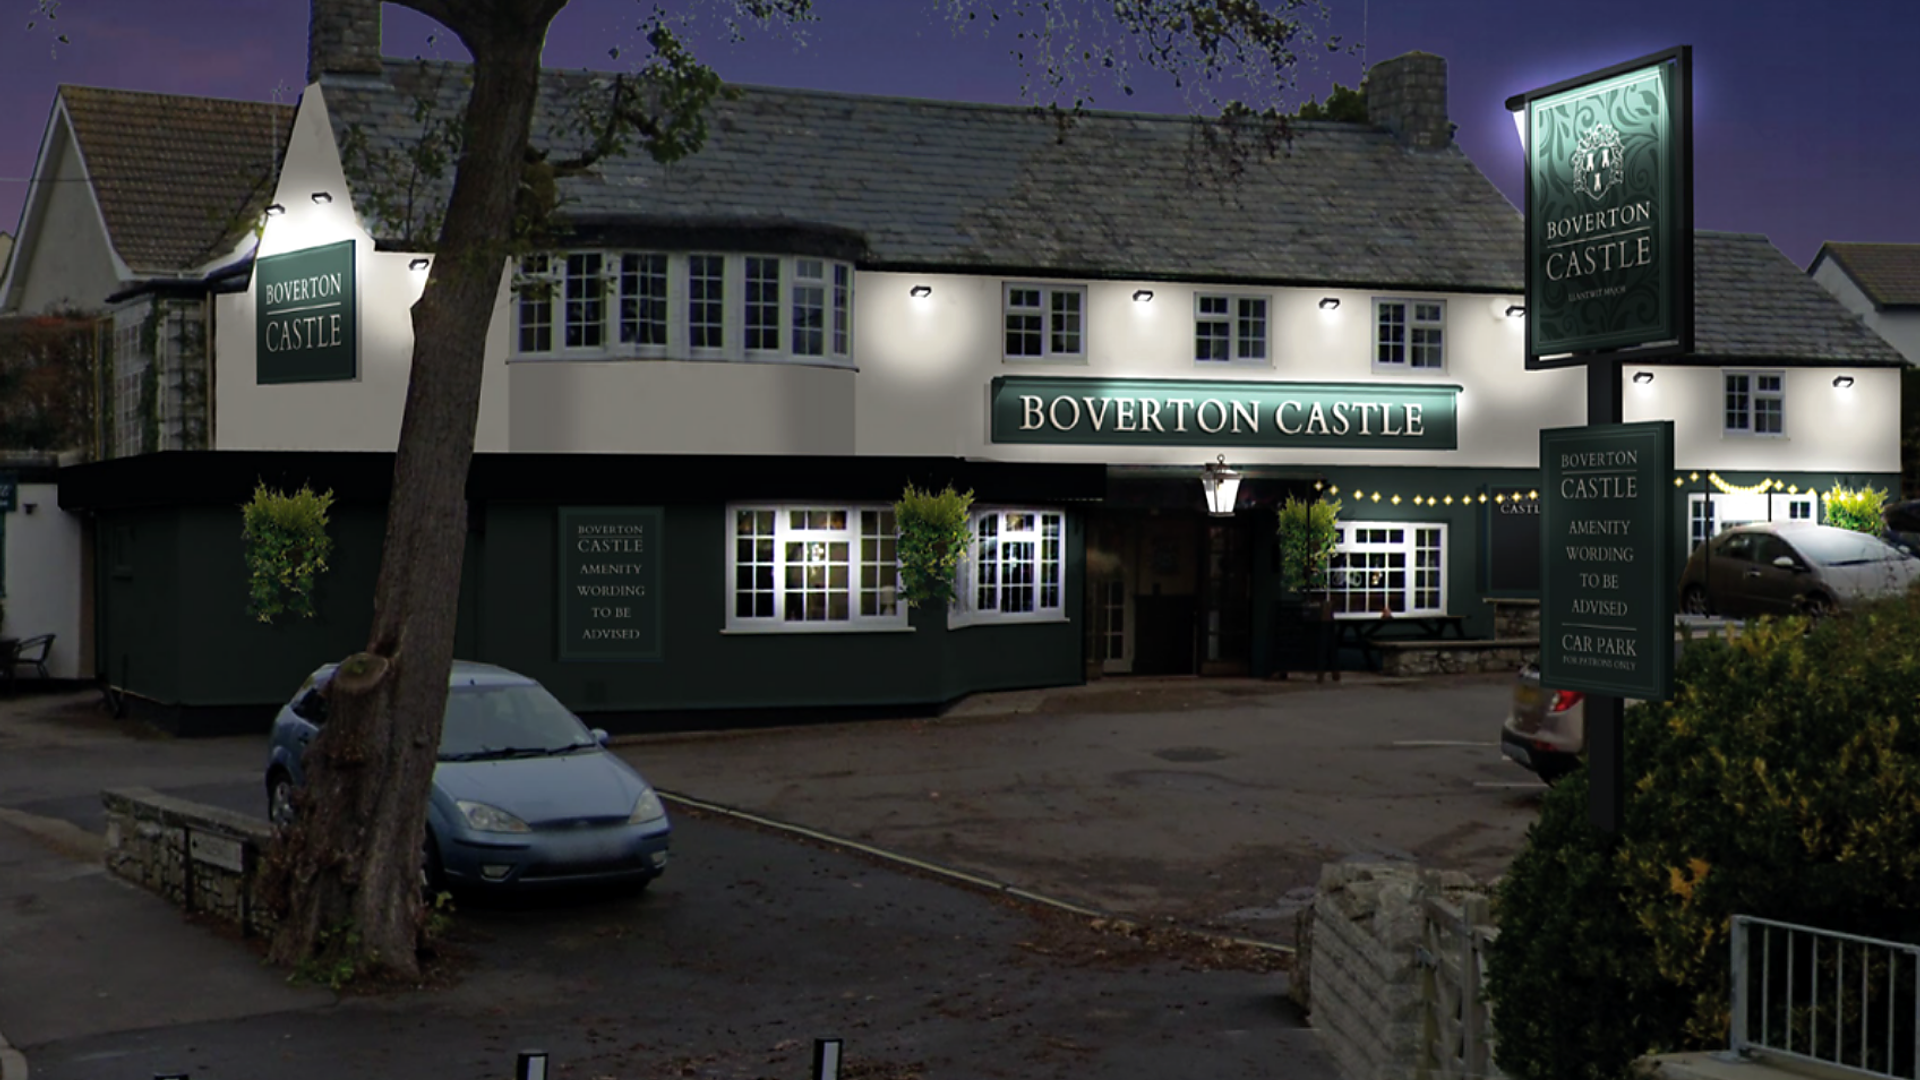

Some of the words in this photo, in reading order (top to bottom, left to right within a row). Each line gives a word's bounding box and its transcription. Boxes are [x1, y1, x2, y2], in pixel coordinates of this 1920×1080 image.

[1547, 201, 1650, 239] BOVERTON
[1546, 236, 1650, 280] CASTLE
[266, 272, 341, 305] BOVERTON
[265, 313, 342, 352] CASTLE
[1019, 394, 1261, 434] BOVERTON
[1275, 399, 1425, 437] CASTLE
[1561, 450, 1638, 468] BOVERTON
[1560, 477, 1638, 500] CASTLE
[1500, 504, 1540, 515] CASTL
[578, 525, 643, 534] BOVERTON
[1568, 519, 1631, 536] AMENITY
[577, 539, 643, 552] CASTLE
[1566, 545, 1634, 563] WORDING
[580, 564, 642, 574] AMENITY
[1579, 573, 1600, 589] TO
[1603, 574, 1619, 589] BE
[577, 585, 645, 596] WORDING
[591, 607, 611, 618] TO
[615, 607, 631, 618] BE
[1571, 599, 1628, 617] ADVISED
[582, 629, 640, 639] ADVISED
[1561, 634, 1593, 652] CAR
[1597, 636, 1638, 657] PARK
[1563, 655, 1578, 666] FOR
[1578, 656, 1613, 670] PATRONS
[1613, 659, 1637, 671] ONLY
